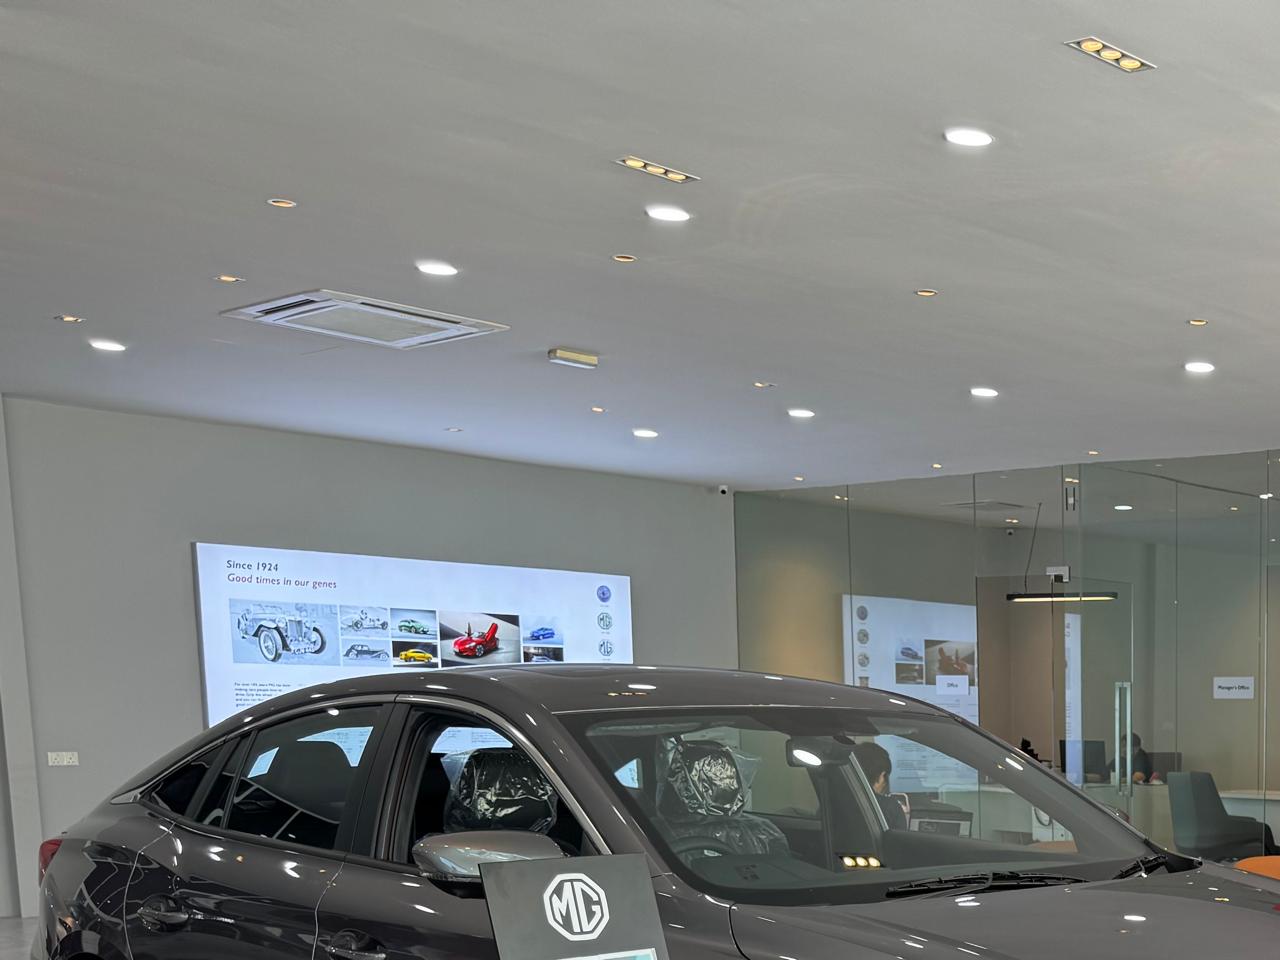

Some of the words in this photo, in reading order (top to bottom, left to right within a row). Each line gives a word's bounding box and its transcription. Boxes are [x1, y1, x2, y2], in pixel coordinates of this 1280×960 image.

[226, 559, 253, 570] Since
[256, 561, 279, 572] 1924
[227, 573, 253, 583] Good
[256, 575, 281, 585] times
[283, 577, 292, 586] in
[294, 579, 310, 587] our
[312, 581, 337, 589] genes
[550, 880, 603, 934] MG
